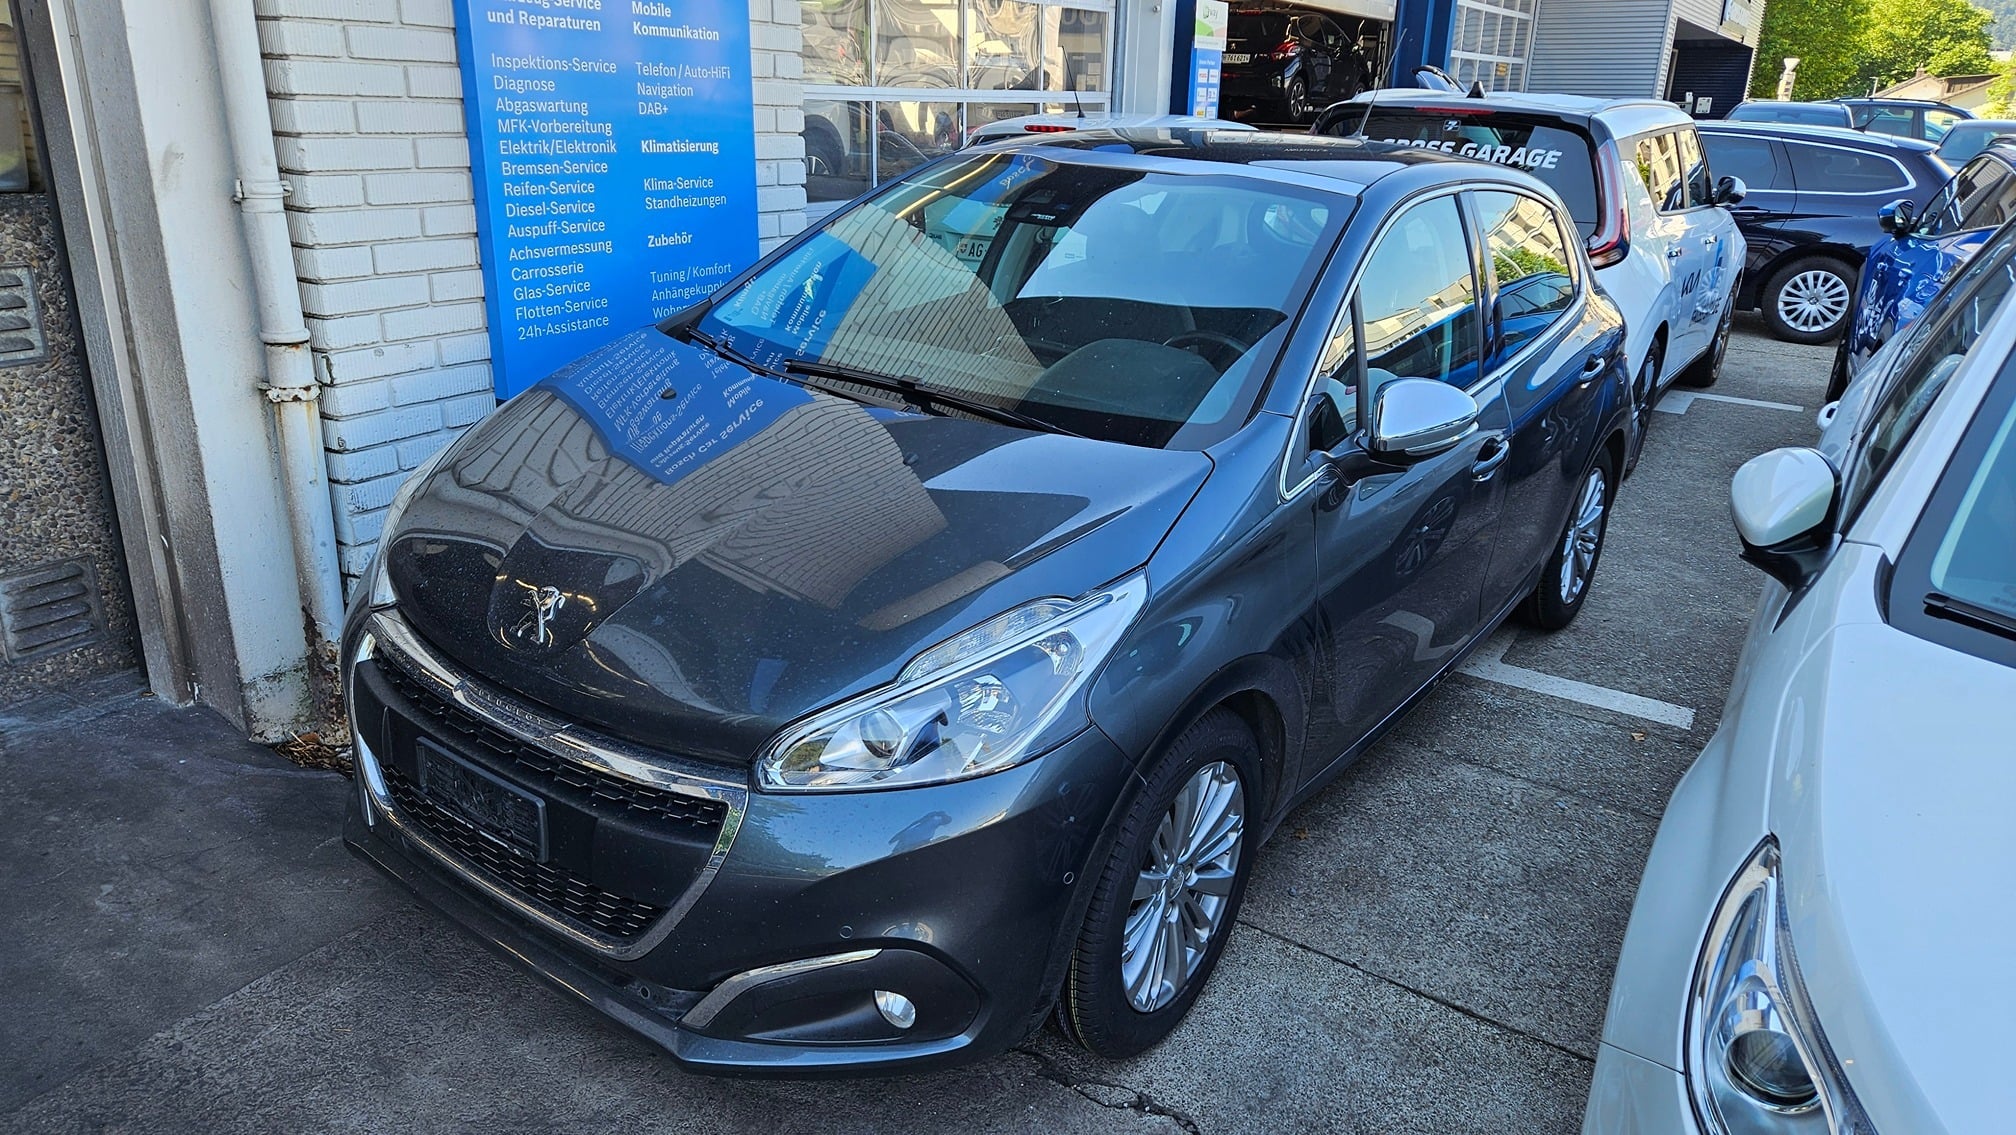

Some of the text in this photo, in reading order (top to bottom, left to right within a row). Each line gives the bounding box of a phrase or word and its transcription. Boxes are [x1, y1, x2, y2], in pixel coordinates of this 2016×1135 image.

[632, 1, 671, 17] Mobile
[487, 9, 601, 31] und Reparaturen
[633, 21, 719, 40] Kommunikation
[491, 52, 617, 73] Inspektions-Service
[635, 62, 676, 77] Telefon
[684, 65, 731, 79] Auto-HiFi
[494, 75, 555, 93] Diagnose
[637, 82, 694, 99] Navigation
[496, 97, 588, 116] Abgaswartung
[639, 102, 669, 115] DAB+
[498, 118, 612, 136] MFK-Vorbereitung
[500, 139, 617, 155] Elektrik/Elektronik
[641, 139, 719, 154] Klimatisierung
[1460, 142, 1563, 169] GARAGE
[501, 160, 608, 175] Bremsen-Service
[504, 180, 595, 196] Reifen-Service
[644, 176, 714, 191] Klima-Service
[506, 200, 595, 217] Diesel-Service
[645, 195, 727, 210] Standheizungen
[508, 219, 606, 238] Auspuff-Service
[647, 231, 693, 248] Zubehör
[509, 240, 612, 261] Achsvermessung
[511, 260, 584, 281] Carrosserie
[650, 269, 685, 283] Tuning
[692, 263, 732, 277] Komfort
[513, 280, 591, 301] Glas-Service
[515, 297, 608, 320] Flotten-Service
[518, 315, 609, 340] 24h-Assistance
